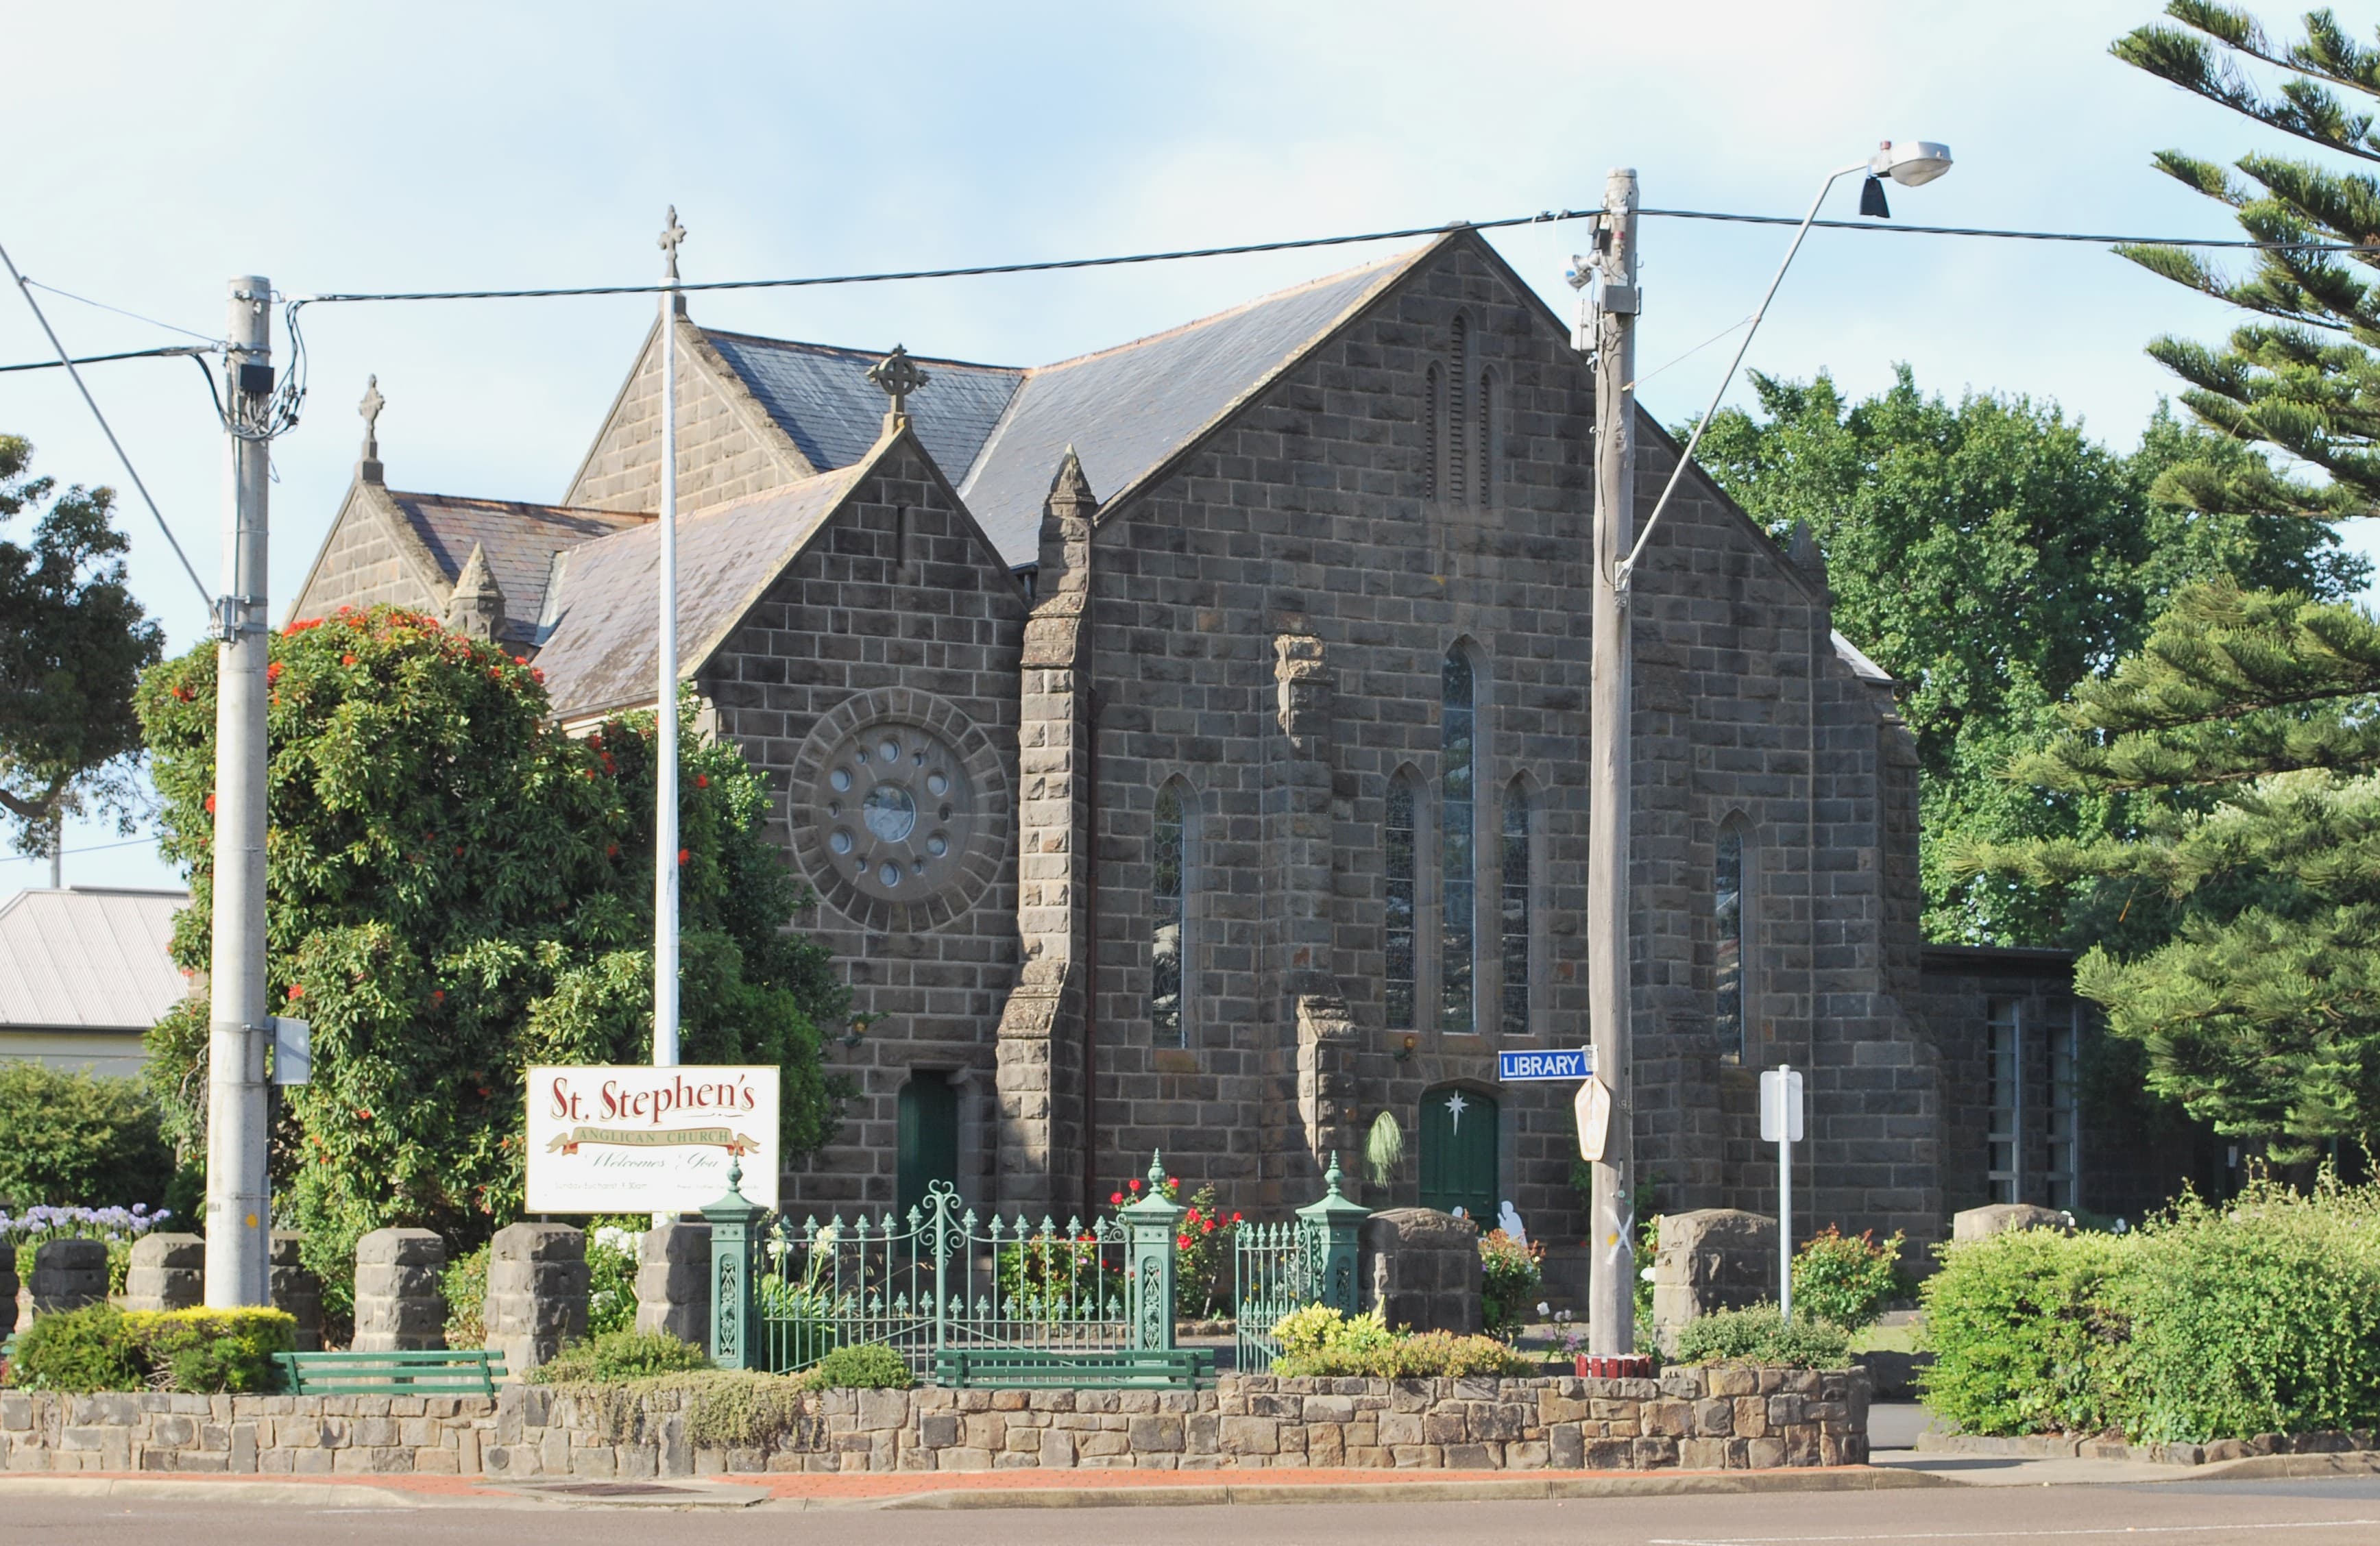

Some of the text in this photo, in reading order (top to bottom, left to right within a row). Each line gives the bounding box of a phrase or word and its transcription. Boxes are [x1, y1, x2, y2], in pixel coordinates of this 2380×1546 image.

[1503, 1055, 1580, 1077] LIBRARY
[552, 1073, 755, 1125] St. Stephen's
[579, 1129, 729, 1143] ANGLICAN CHURCH
[590, 1151, 719, 1168] Welcomes You
